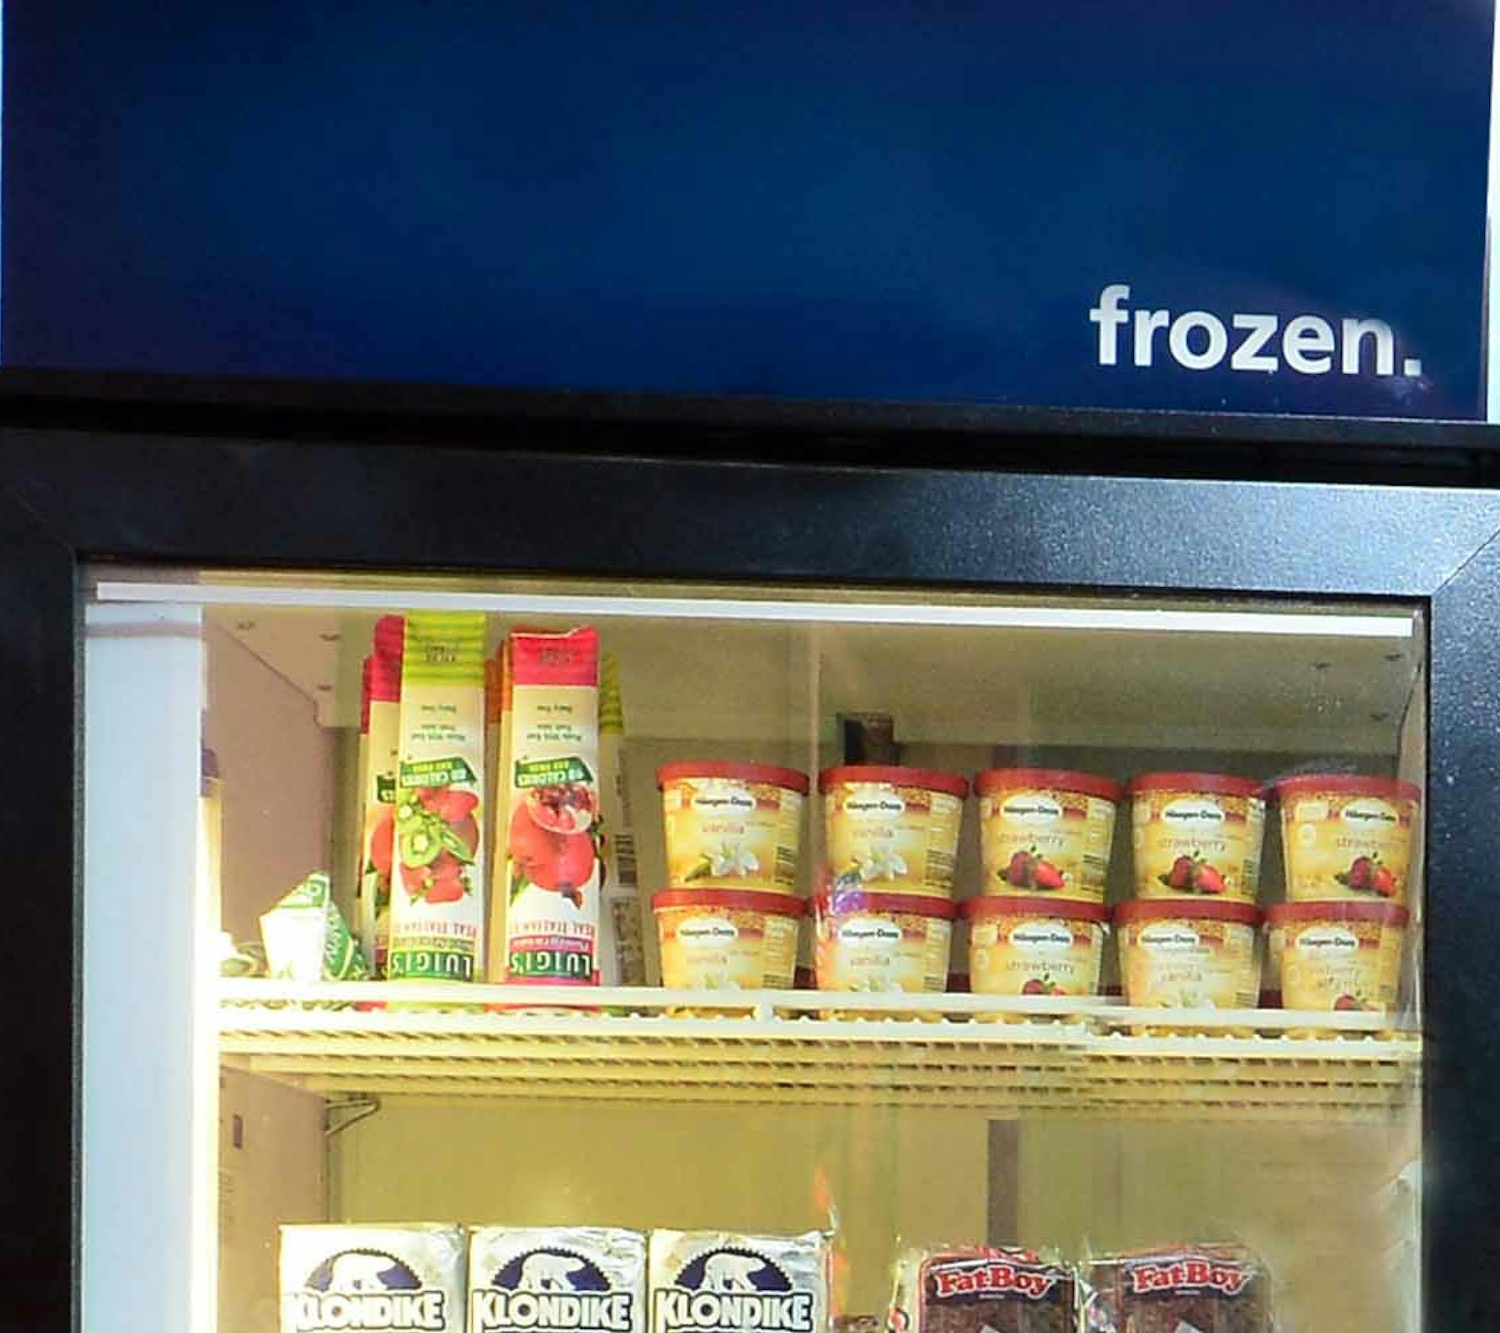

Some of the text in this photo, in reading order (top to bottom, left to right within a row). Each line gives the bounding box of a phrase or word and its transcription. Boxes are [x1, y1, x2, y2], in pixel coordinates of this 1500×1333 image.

[1089, 284, 1422, 377] frozen.
[391, 951, 473, 979] LUIGI'S
[508, 950, 592, 978] LUIGI'S
